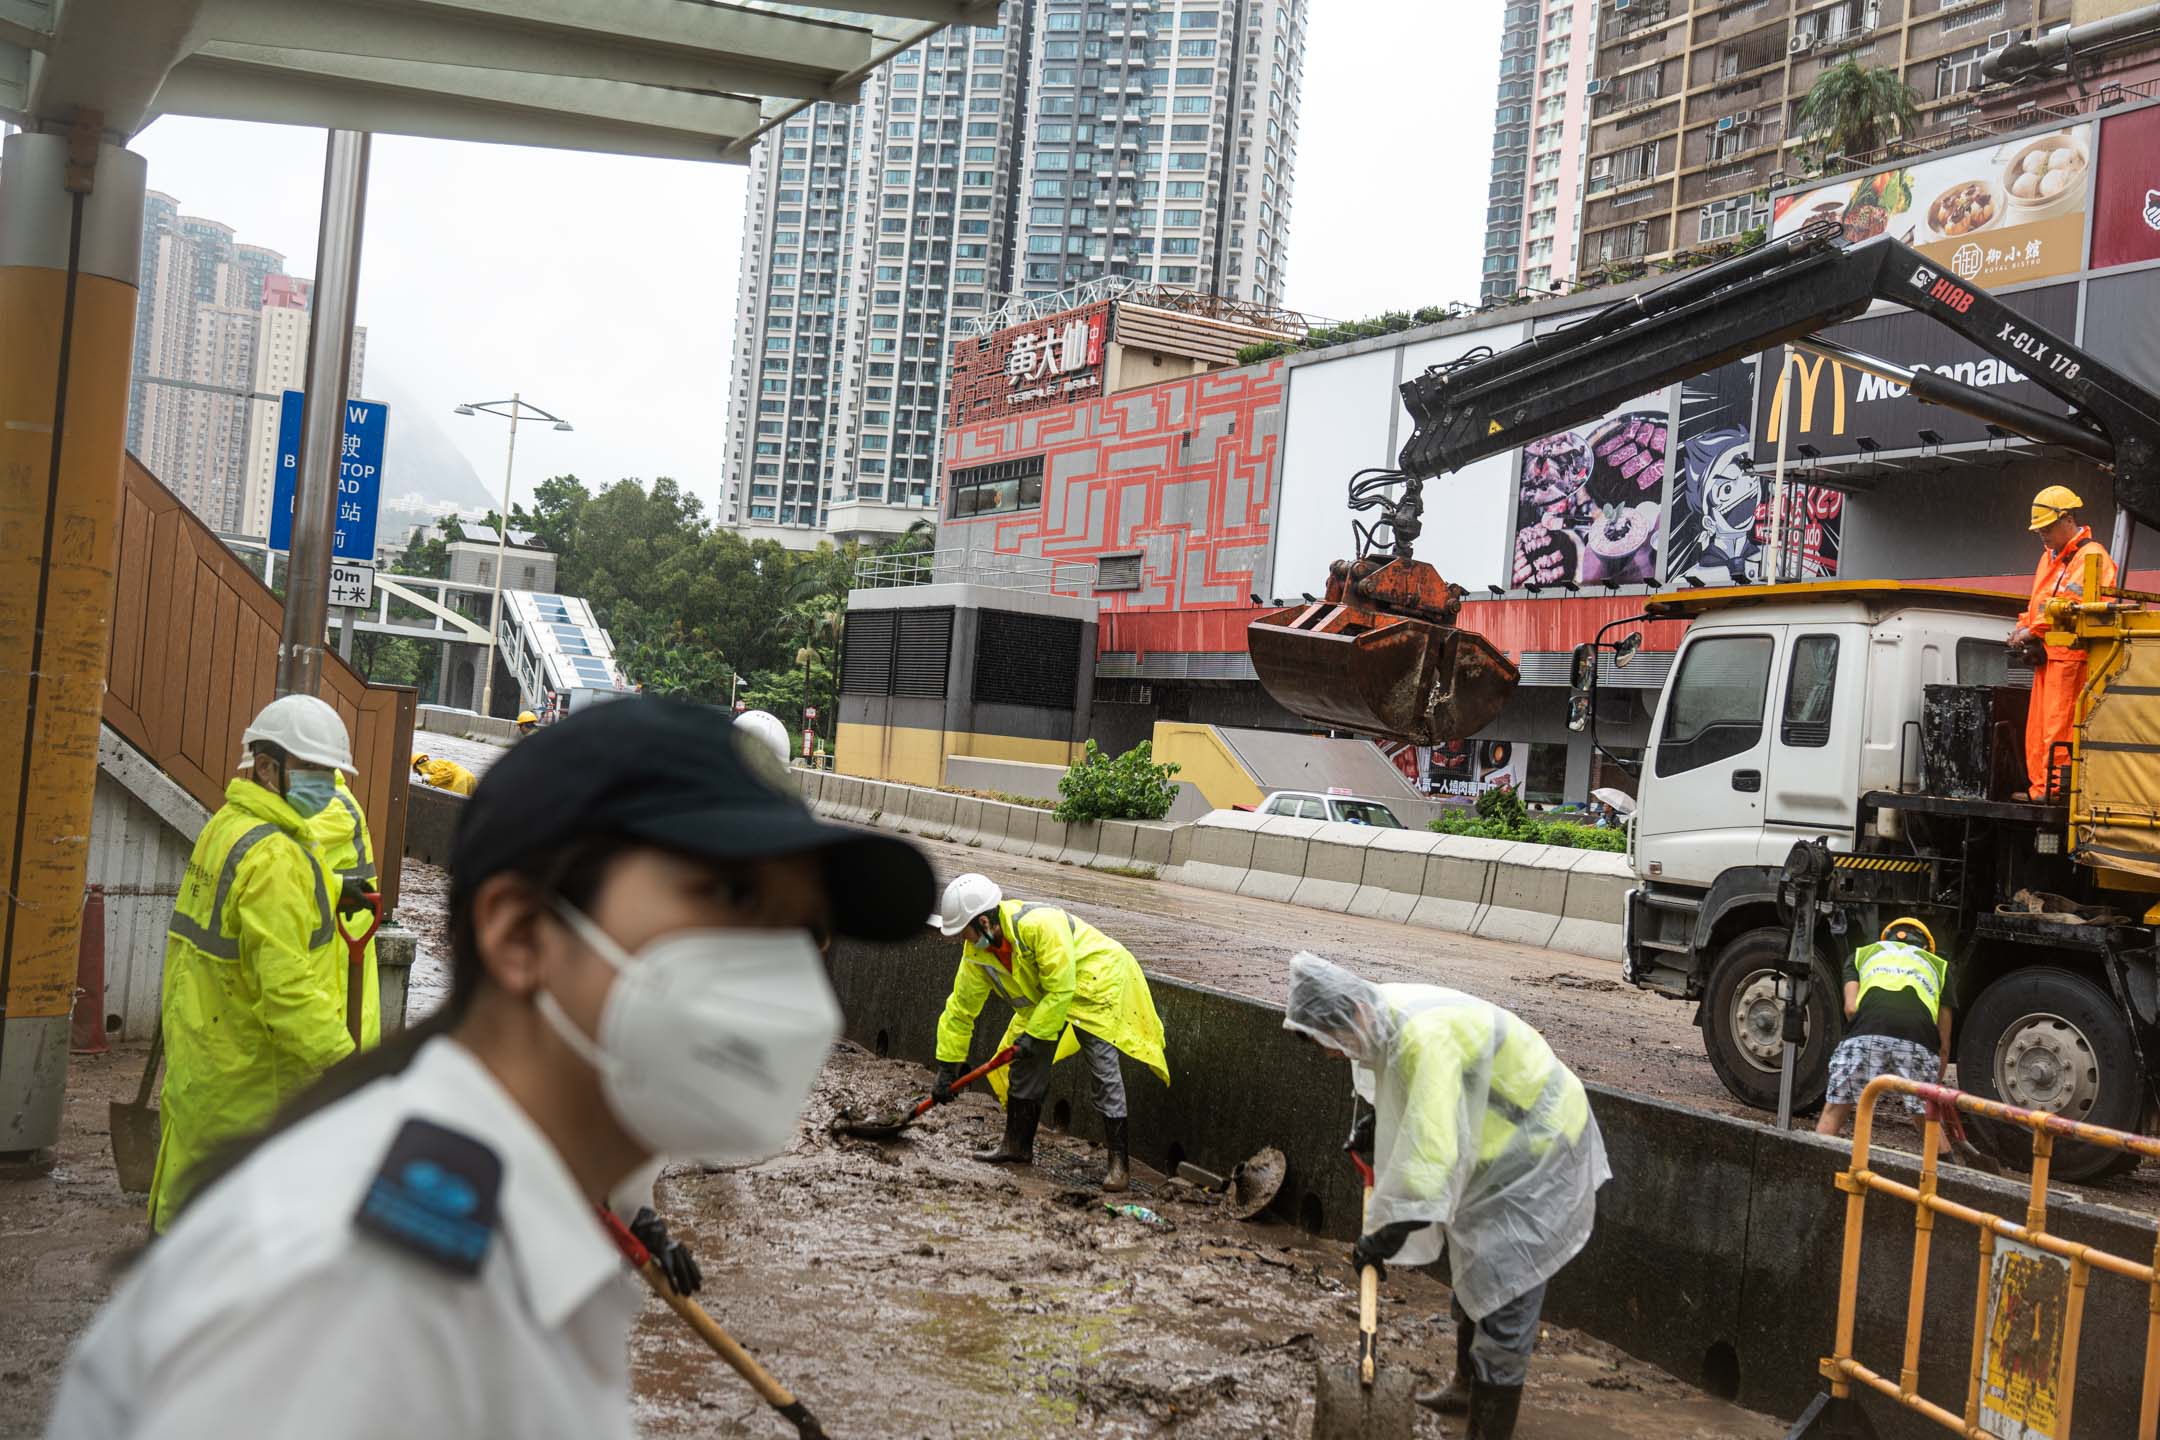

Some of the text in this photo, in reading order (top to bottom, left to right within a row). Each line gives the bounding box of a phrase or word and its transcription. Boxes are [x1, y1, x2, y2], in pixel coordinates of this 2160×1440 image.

[1984, 258, 2041, 273] ROYAL BISTRO
[1930, 277, 1975, 314] HIAB
[1996, 322, 2081, 380] X-CLX 178
[349, 406, 369, 424] W
[341, 433, 361, 458] 駛
[341, 462, 375, 479] TOP
[341, 502, 361, 522] 站
[331, 568, 361, 583] 0m
[332, 586, 366, 602] 十米
